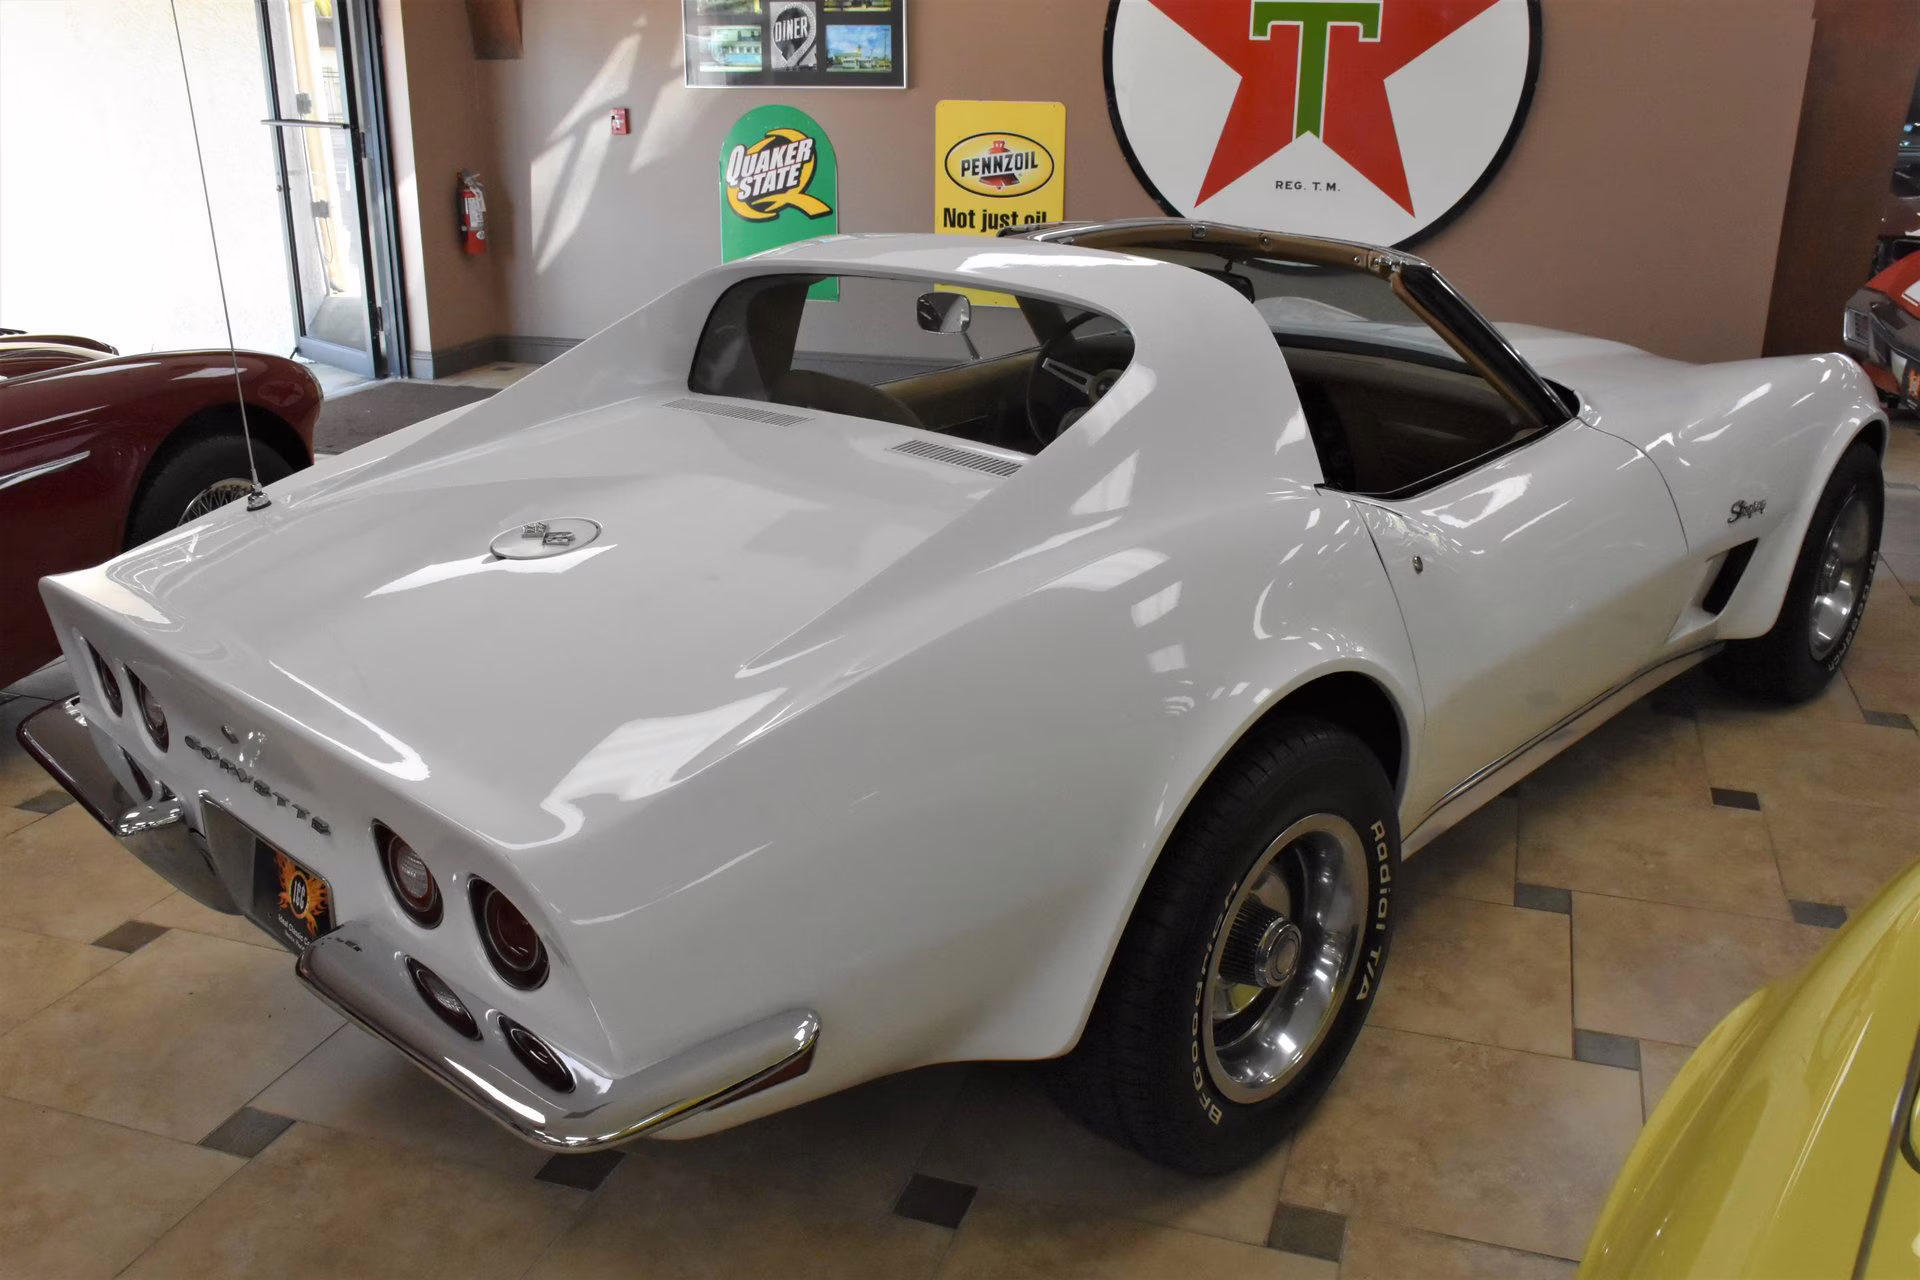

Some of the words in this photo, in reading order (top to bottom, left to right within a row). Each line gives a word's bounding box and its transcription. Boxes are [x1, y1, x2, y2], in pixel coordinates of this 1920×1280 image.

[775, 16, 808, 42] DINER
[1249, 0, 1384, 142] T
[726, 138, 813, 186] QUAKER
[738, 164, 801, 200] STATE
[961, 151, 1038, 177] PENNZOIL
[1275, 180, 1307, 191] REG.
[943, 207, 975, 229] Not
[981, 209, 1018, 233] just
[185, 735, 331, 836] CORVETTE
[1370, 820, 1392, 930] Radial
[1356, 946, 1382, 1001] T/A
